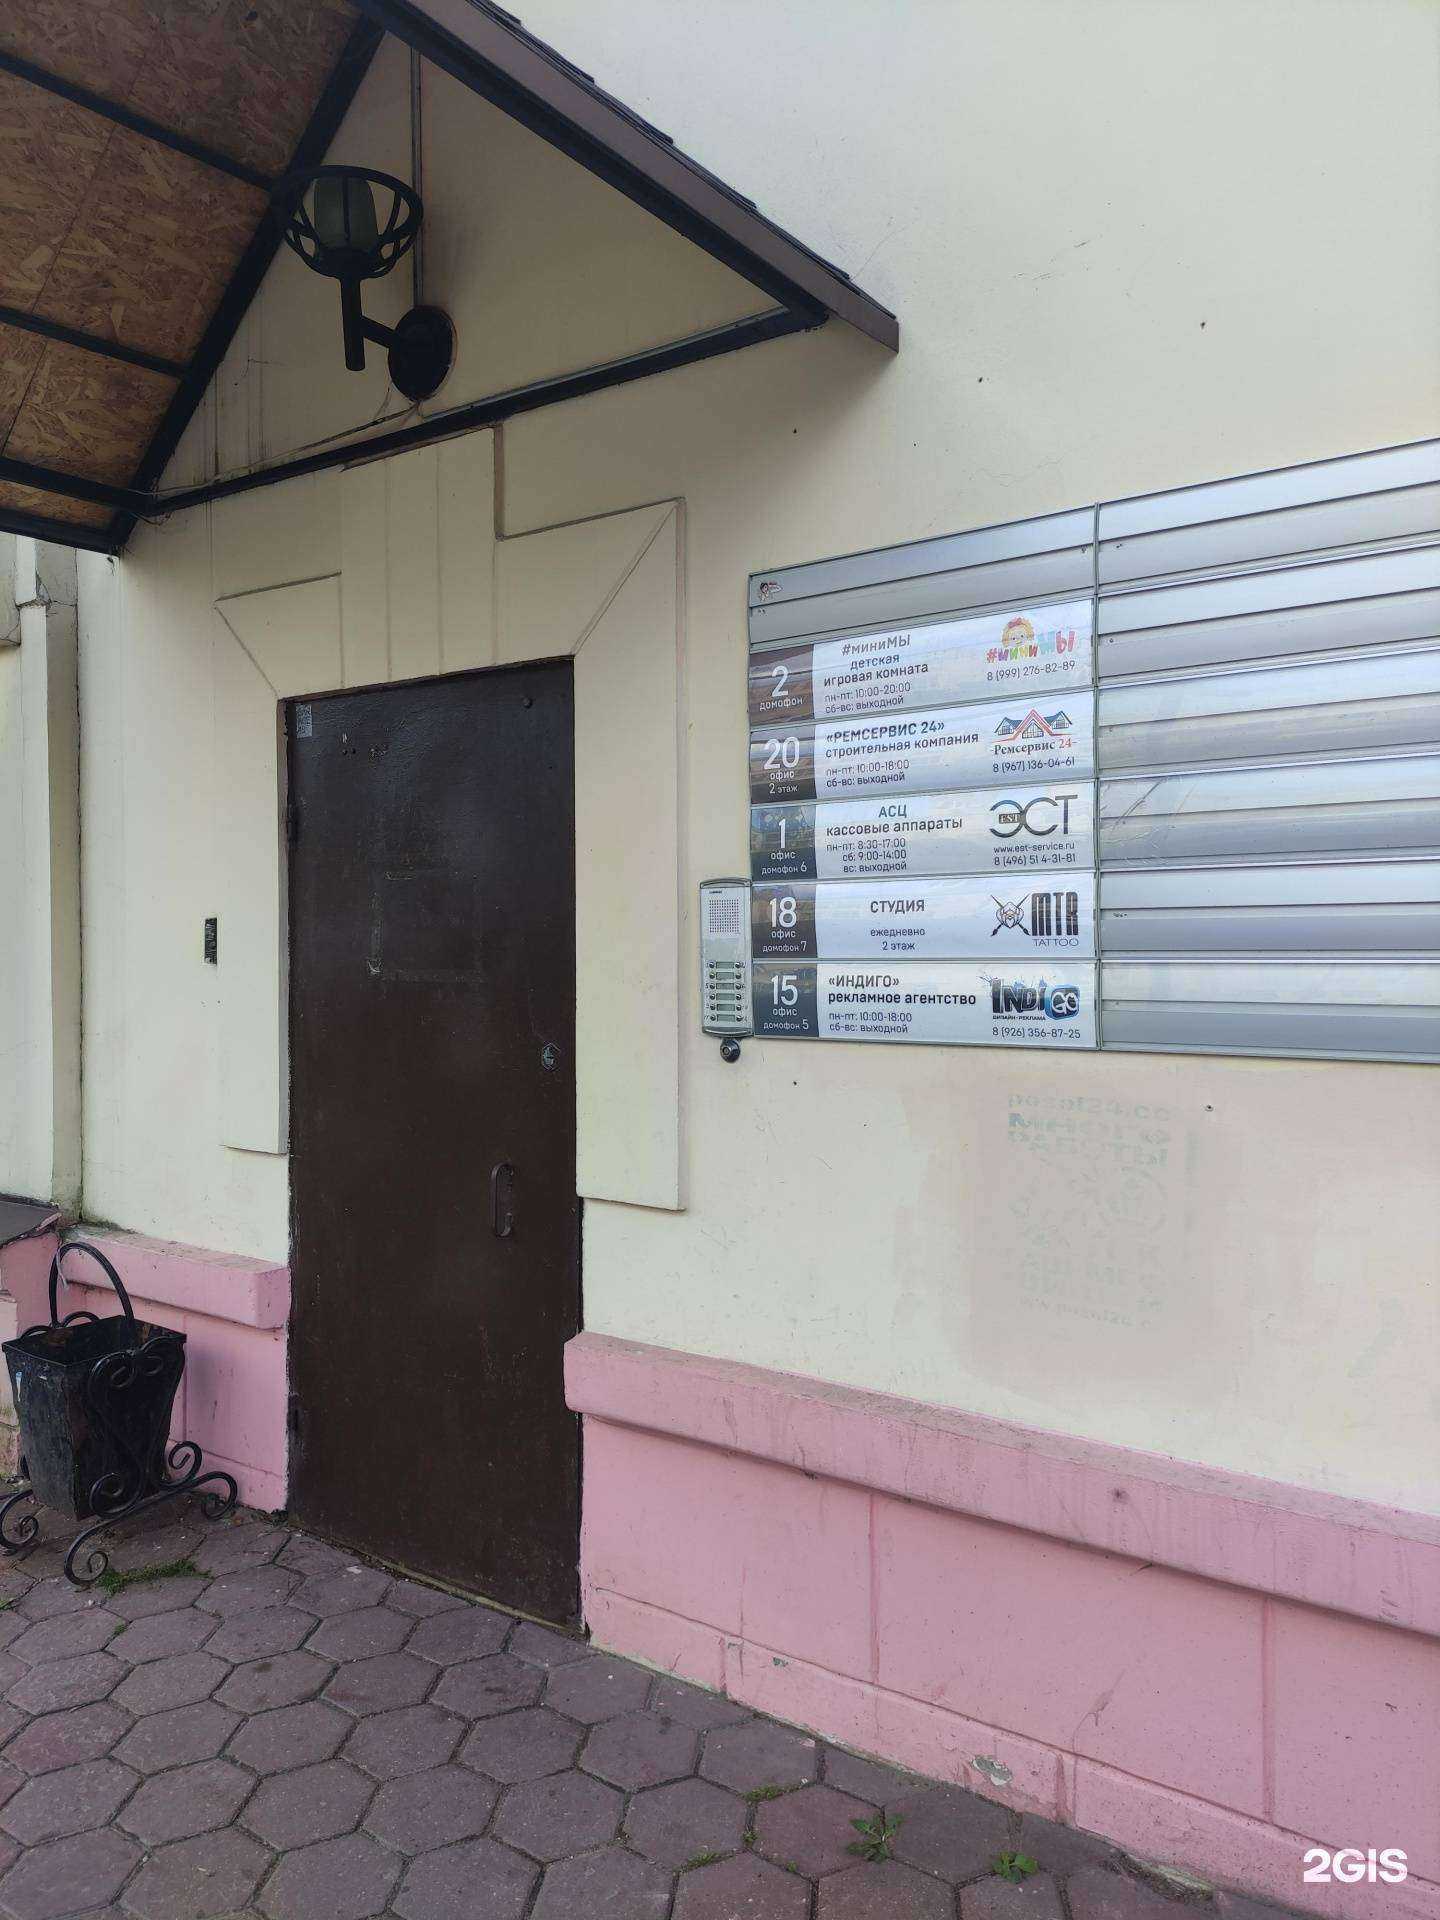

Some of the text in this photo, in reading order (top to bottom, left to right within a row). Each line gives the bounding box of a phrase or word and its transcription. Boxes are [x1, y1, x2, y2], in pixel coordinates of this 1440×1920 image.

[842, 634, 911, 656] #миниМЫ
[851, 654, 900, 671] детская
[824, 663, 929, 687] игровая комната
[987, 660, 1076, 681] 8 (999) 276-82-89
[771, 665, 789, 698] 2
[825, 682, 911, 703] пн-пт: 10:00-20:00
[759, 696, 803, 712] домофон
[825, 696, 904, 714] сб-вс: выходной
[826, 720, 945, 743] «РЕМСЕРВИС 24»
[763, 736, 800, 770] 20
[825, 732, 979, 759] строительная компания
[994, 738, 1073, 756] Ремсервис 24
[826, 759, 910, 777] пн-пт: 10:00-18:00
[993, 756, 1075, 774] 8 (967) 136-04-61
[770, 770, 795, 782] офис
[826, 772, 906, 788] сб-вс: выходной
[769, 783, 799, 794] 2 этаж
[878, 804, 908, 819] АСЦ
[989, 794, 1078, 838] ЭСТ
[778, 818, 786, 848] 1
[826, 817, 963, 837] кассовые аппараты
[826, 838, 906, 852] пн-пт: 8:30-17:00
[994, 842, 1075, 854] www.est-service.ru
[770, 850, 796, 861] офис
[842, 850, 907, 862] сб: 9:00-14:00
[994, 856, 1000, 866] 8
[1003, 855, 1027, 867] (496)
[761, 861, 808, 876] домофон 6
[843, 861, 907, 873] вс: выходной
[769, 896, 797, 928] 18
[870, 899, 925, 915] СТУДИЯ
[771, 929, 796, 940] офис
[870, 928, 925, 938] ежедневно
[762, 940, 807, 953] домофон 7
[882, 941, 916, 951] 2 этаж
[1032, 938, 1079, 947] TATTOO
[829, 975, 900, 989] «ИНДИГО»
[771, 974, 798, 1006] 15
[828, 992, 977, 1006] рекламное агентство
[772, 1007, 798, 1018] офис
[829, 1012, 912, 1023] пн-пт: 10:00-18:00
[763, 1018, 809, 1030] домофон 5
[829, 1023, 908, 1035] сб-вс: выходной
[993, 1027, 1081, 1039] 8 (926) 356-87-25
